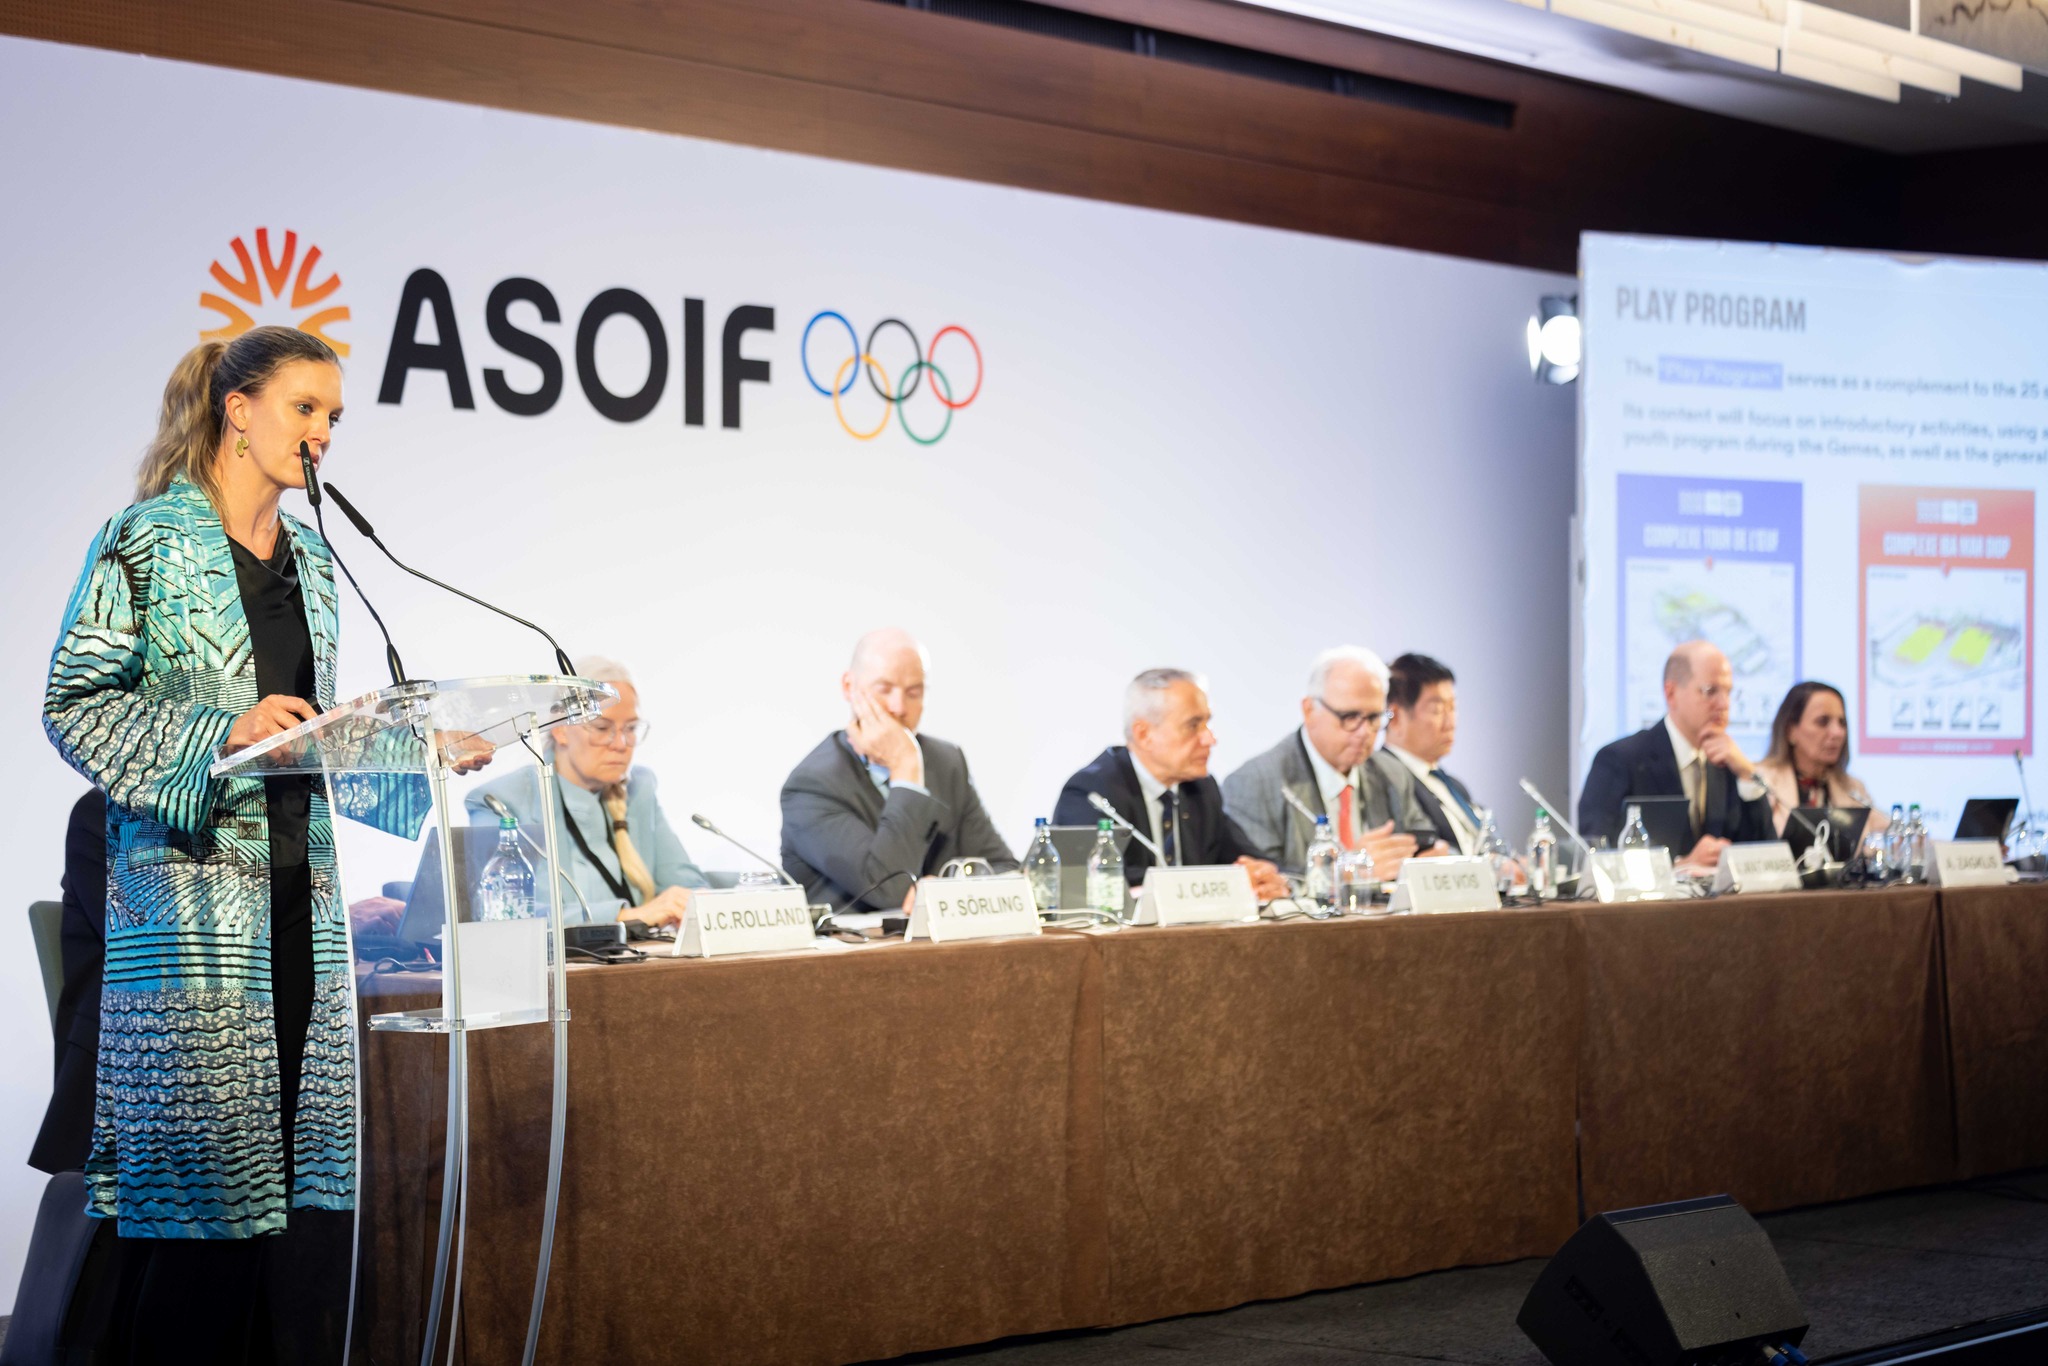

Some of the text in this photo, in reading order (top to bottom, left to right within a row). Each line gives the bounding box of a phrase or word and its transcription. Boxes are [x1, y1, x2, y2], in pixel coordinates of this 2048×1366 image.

[1616, 286, 1806, 333] PLAY PROGRAM
[376, 267, 776, 429] ASOIF
[1874, 378, 1969, 397] complement
[1973, 381, 1988, 396] to
[1992, 380, 2016, 397] the
[1176, 881, 1231, 900] J. CARR
[1433, 873, 1451, 891] DE
[1452, 872, 1480, 890] VOS
[939, 895, 1024, 918] P. SÖRLING
[704, 907, 806, 931] J.C.ROLLAND
